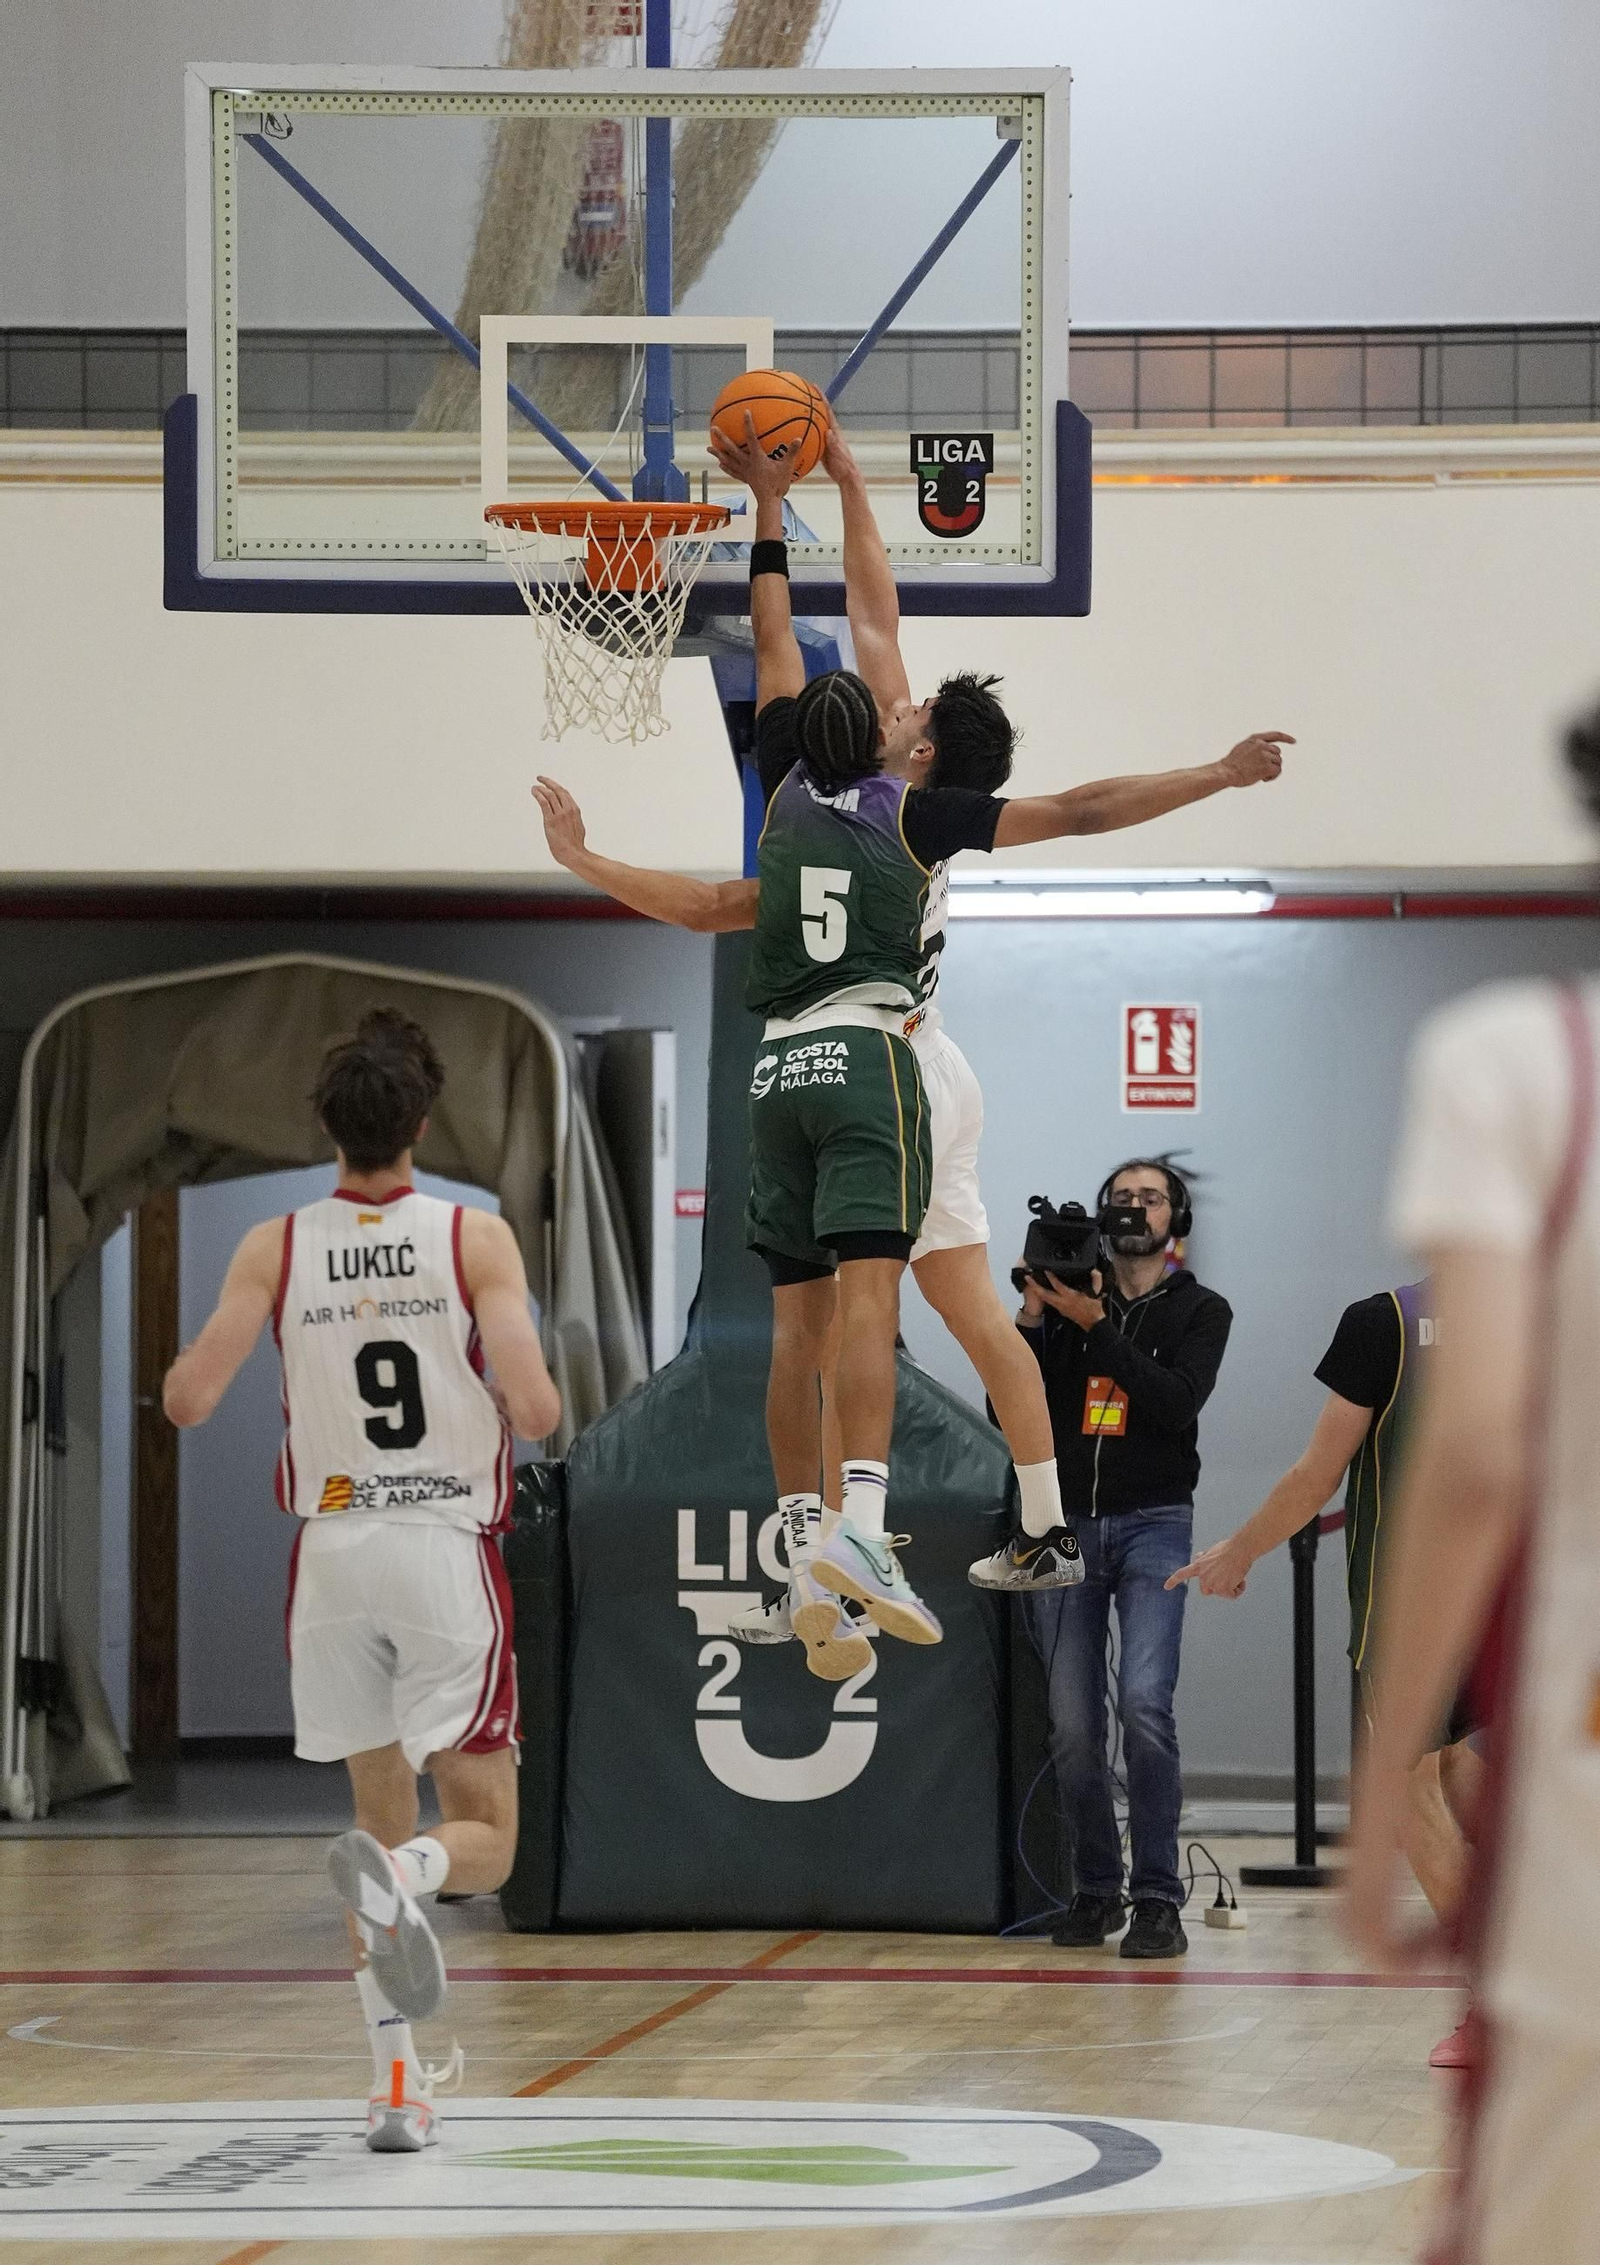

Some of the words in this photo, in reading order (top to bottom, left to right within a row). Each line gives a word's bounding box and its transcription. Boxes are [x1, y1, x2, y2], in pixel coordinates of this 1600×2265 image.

[917, 439, 986, 463] LIGA
[923, 480, 938, 503] 2
[965, 480, 980, 503] 2
[800, 865, 852, 963] 5
[785, 1041, 849, 1063] COSTA
[780, 1060, 810, 1077] DEL
[812, 1057, 848, 1071] SOL
[780, 1071, 847, 1092] MÁLAGA
[327, 1236, 416, 1283] LUKIĆ
[302, 1307, 334, 1326] AIR
[354, 1339, 427, 1451] 9
[351, 1491, 377, 1509] DE
[788, 1508, 808, 1548] UNICAJA
[696, 1639, 742, 1711] 2
